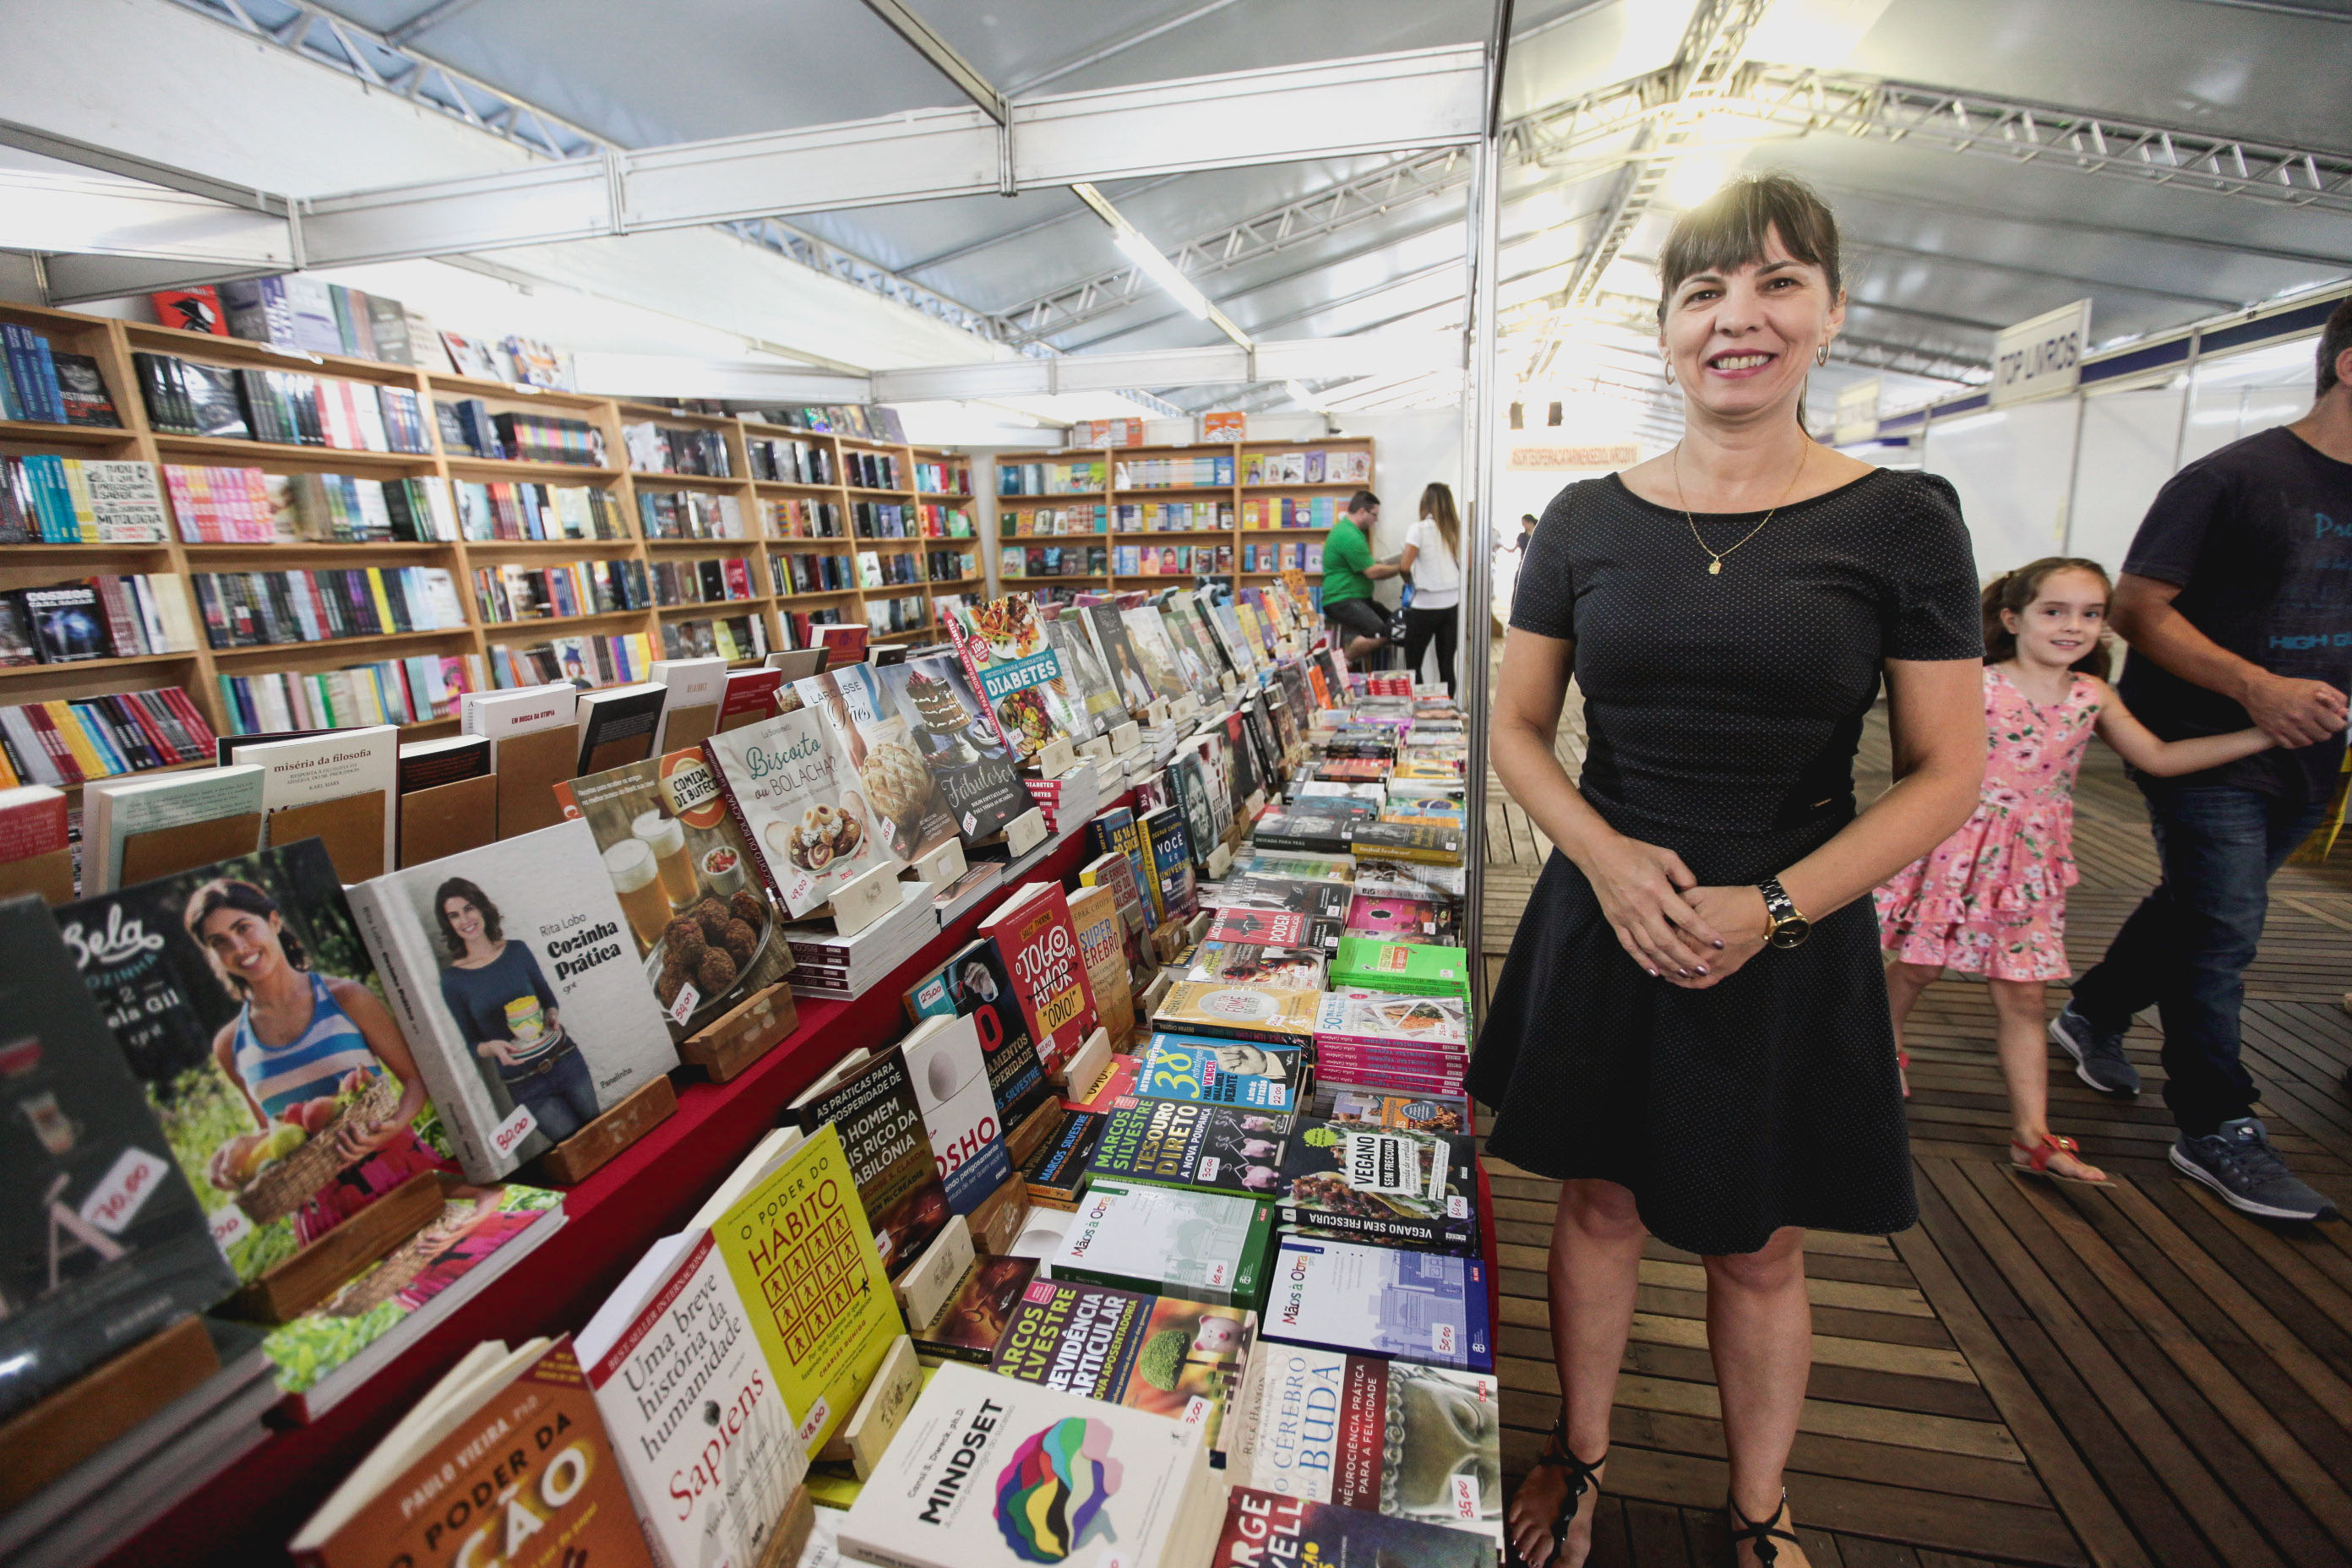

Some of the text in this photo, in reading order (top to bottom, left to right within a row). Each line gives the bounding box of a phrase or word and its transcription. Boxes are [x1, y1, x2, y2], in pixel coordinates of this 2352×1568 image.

[2000, 332, 2077, 386] TOP LIVROS
[947, 618, 980, 689] COMBATER DIABETES
[972, 641, 985, 655] 100
[809, 681, 863, 705] LAROUSSE
[986, 660, 1057, 697] DIABETES
[520, 714, 533, 724] BUSCA
[540, 710, 555, 719] UTOPIA
[827, 696, 871, 731] Pães
[274, 760, 314, 772] miséria
[333, 749, 371, 763] filosofia
[673, 769, 709, 792] COMIDA
[746, 732, 822, 781] Biscoito
[754, 756, 840, 799] ou BOLACHA?
[673, 777, 719, 808] DI BUTECO
[724, 792, 750, 832] BOLACHA?
[1157, 831, 1184, 856] VOCÊ
[1100, 863, 1128, 885] OS ERROS
[1159, 858, 1190, 881] UNIVERSO
[539, 912, 587, 937] Rita Lobo
[547, 921, 619, 959] Cozinha
[1021, 924, 1034, 939] SALLY
[1079, 918, 1112, 950] SUPER
[1210, 920, 1224, 939] JACOB
[1268, 914, 1291, 943] PODER
[553, 943, 622, 982] Prática
[1015, 924, 1076, 983] O JOGO DO
[1032, 958, 1073, 1010] AMOR
[1225, 995, 1249, 1015] FOME
[1322, 1015, 1342, 1032] 50
[599, 1068, 633, 1089] Panelinha
[1005, 1065, 1041, 1100] SILVESTRE
[1139, 1063, 1153, 1092] ARTHUR
[1146, 1048, 1200, 1098] 38
[1192, 1048, 1205, 1079] estratégias
[1202, 1061, 1217, 1102] PARA VENCER
[1212, 1072, 1225, 1102] QUALQUER
[1224, 1075, 1239, 1102] DEBATE
[817, 1062, 896, 1119] AS PRÁTICAS PARA
[824, 1070, 903, 1124] PROSPERIDADE DE
[1246, 1086, 1255, 1097] arte
[1255, 1080, 1268, 1105] ter razão
[847, 1097, 900, 1140] HOMEM
[863, 1110, 919, 1159] RICO DA
[1095, 1111, 1131, 1168] MARCOS
[1113, 1099, 1155, 1170] SILVESTRE
[1133, 1102, 1176, 1173] TESOURO
[1154, 1105, 1199, 1176] DIRETO
[1180, 1108, 1212, 1179] A NOVA POUPANÇA
[853, 1133, 917, 1190] ABILÔNIA
[934, 1116, 995, 1181] OSHO
[959, 1143, 999, 1182] perigosamente
[1039, 1152, 1059, 1183] MARCOS
[1060, 1113, 1089, 1152] SILVESTRE
[1354, 1135, 1375, 1185] VEGANO
[1383, 1140, 1395, 1188] SEM FRESCURA
[741, 1157, 829, 1240] O PODER DO
[748, 1179, 839, 1277] HÁBITO
[1071, 1229, 1095, 1258] Mãos
[1090, 1196, 1112, 1219] Obra
[1309, 1212, 1433, 1239] VEGANO SEM FRESCURA
[652, 1246, 710, 1313] INTERNACIONAL
[1282, 1255, 1309, 1326] Mãos à Obra
[623, 1272, 717, 1393] Uma breve
[819, 1319, 867, 1379] CHARLES DUHIGG
[997, 1306, 1043, 1379] ARCOS
[1020, 1288, 1078, 1380] LVESTRE
[1045, 1293, 1104, 1391] REVIDÊNCIA
[1068, 1295, 1128, 1399] ARTICULAR
[1105, 1298, 1139, 1379] APOSENTADORIA
[1118, 1304, 1151, 1386] para depender governos
[636, 1300, 727, 1423] história da
[640, 1314, 742, 1463] humanidade
[1243, 1376, 1266, 1456] RICK HANSON
[1270, 1356, 1307, 1493] O CÉREBRO
[1298, 1364, 1342, 1498] DE BUDA
[1342, 1364, 1365, 1506] NEUROCIÊNCIA PRÁTICA
[1358, 1377, 1378, 1494] PARA A FELICIDADE
[669, 1368, 765, 1522] Sapiens
[746, 1430, 770, 1471] Harari
[918, 1398, 1004, 1527] MINDSET
[964, 1404, 1016, 1496] psicologia sucesso
[424, 1448, 528, 1551] PODER
[534, 1411, 571, 1451] DA
[906, 1472, 928, 1499] Carol
